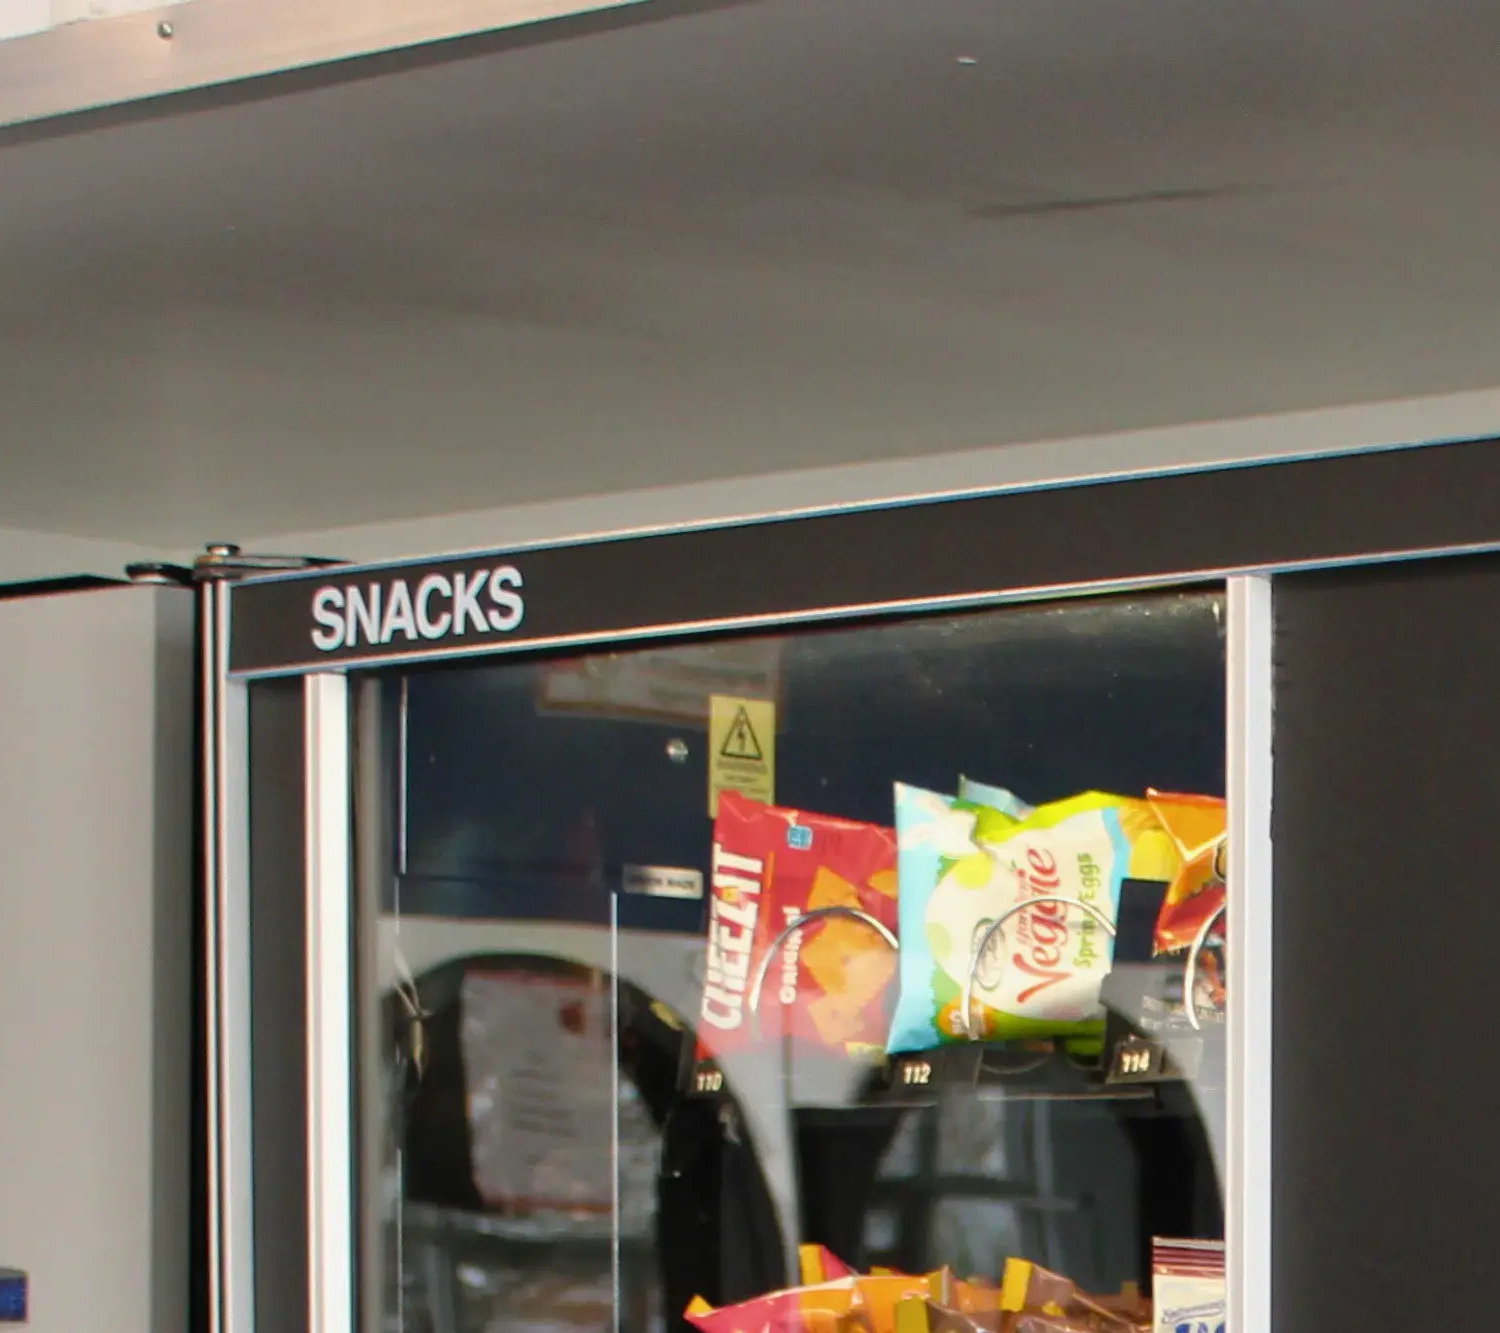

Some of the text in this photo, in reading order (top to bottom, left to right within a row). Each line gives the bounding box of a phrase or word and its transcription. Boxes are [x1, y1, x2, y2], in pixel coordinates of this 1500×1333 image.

[310, 567, 525, 652] SNACKS
[1075, 851, 1101, 901] Eggs
[1012, 847, 1074, 1005] Veggie
[903, 1062, 931, 1085] 112
[1122, 1052, 1151, 1074] 114
[697, 1071, 723, 1092] 110
